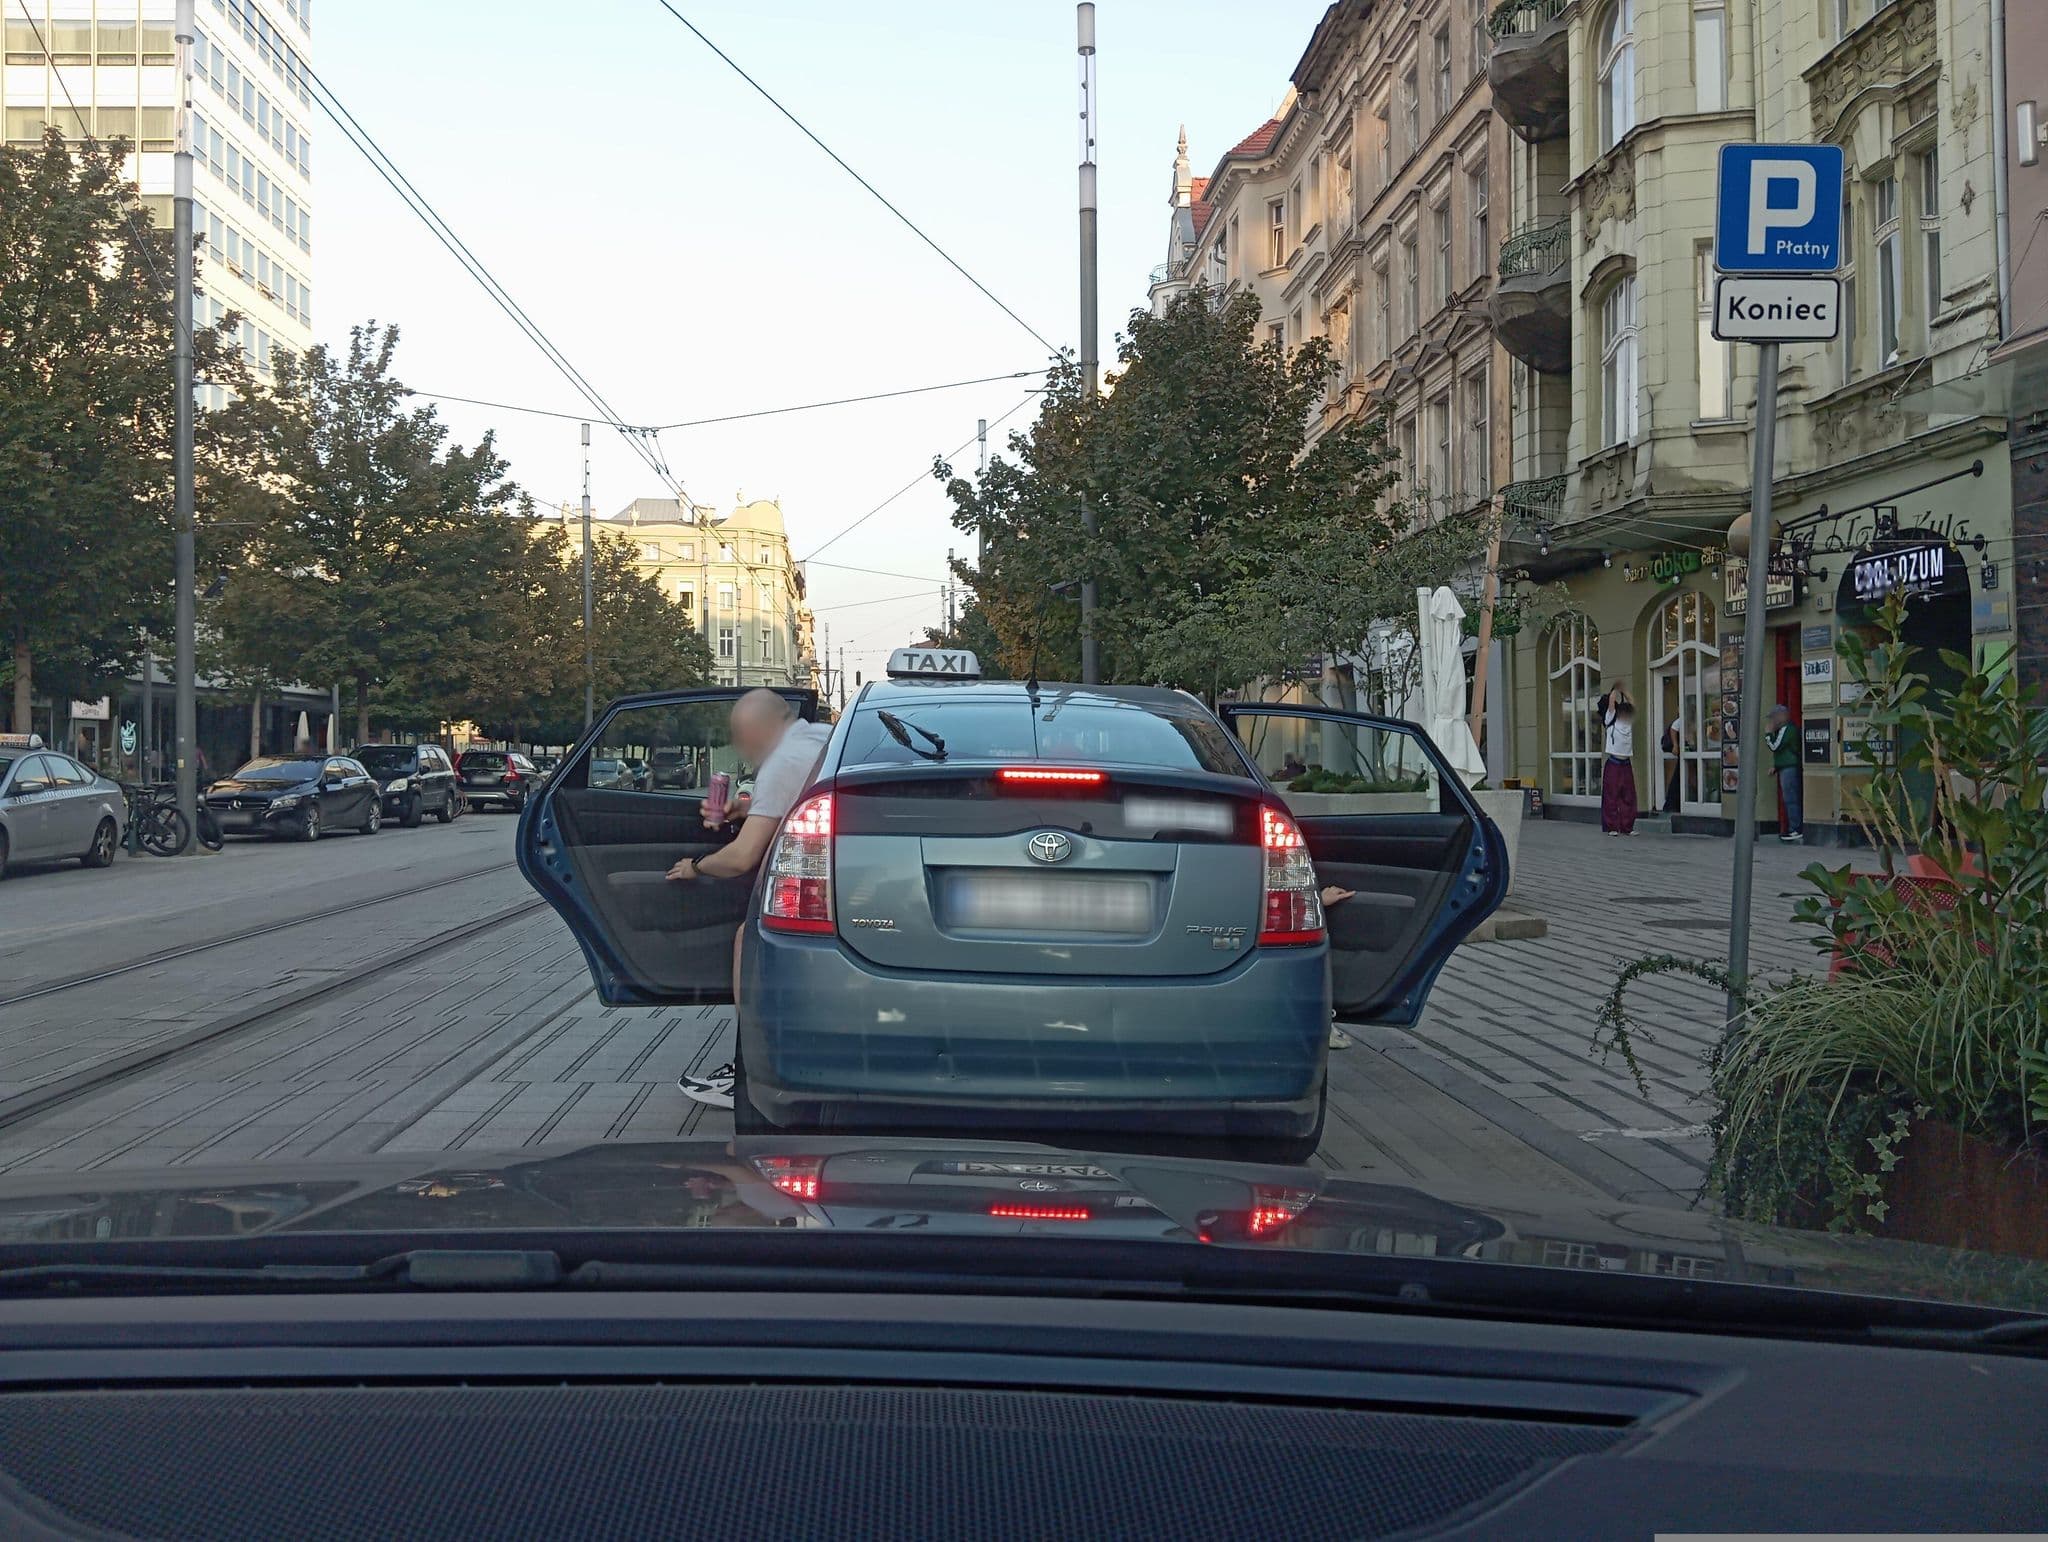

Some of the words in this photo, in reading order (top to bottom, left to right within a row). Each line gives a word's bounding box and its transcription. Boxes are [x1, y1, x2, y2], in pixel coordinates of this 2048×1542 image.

[1747, 159, 1817, 255] P
[1775, 240, 1831, 260] Płatny
[1728, 296, 1828, 321] Koniec
[1732, 600, 1747, 612] BES
[1765, 592, 1787, 606] OWN!
[903, 653, 967, 673] TAXI
[851, 918, 895, 929] TOYOTA
[1185, 925, 1248, 936] PRIUS
